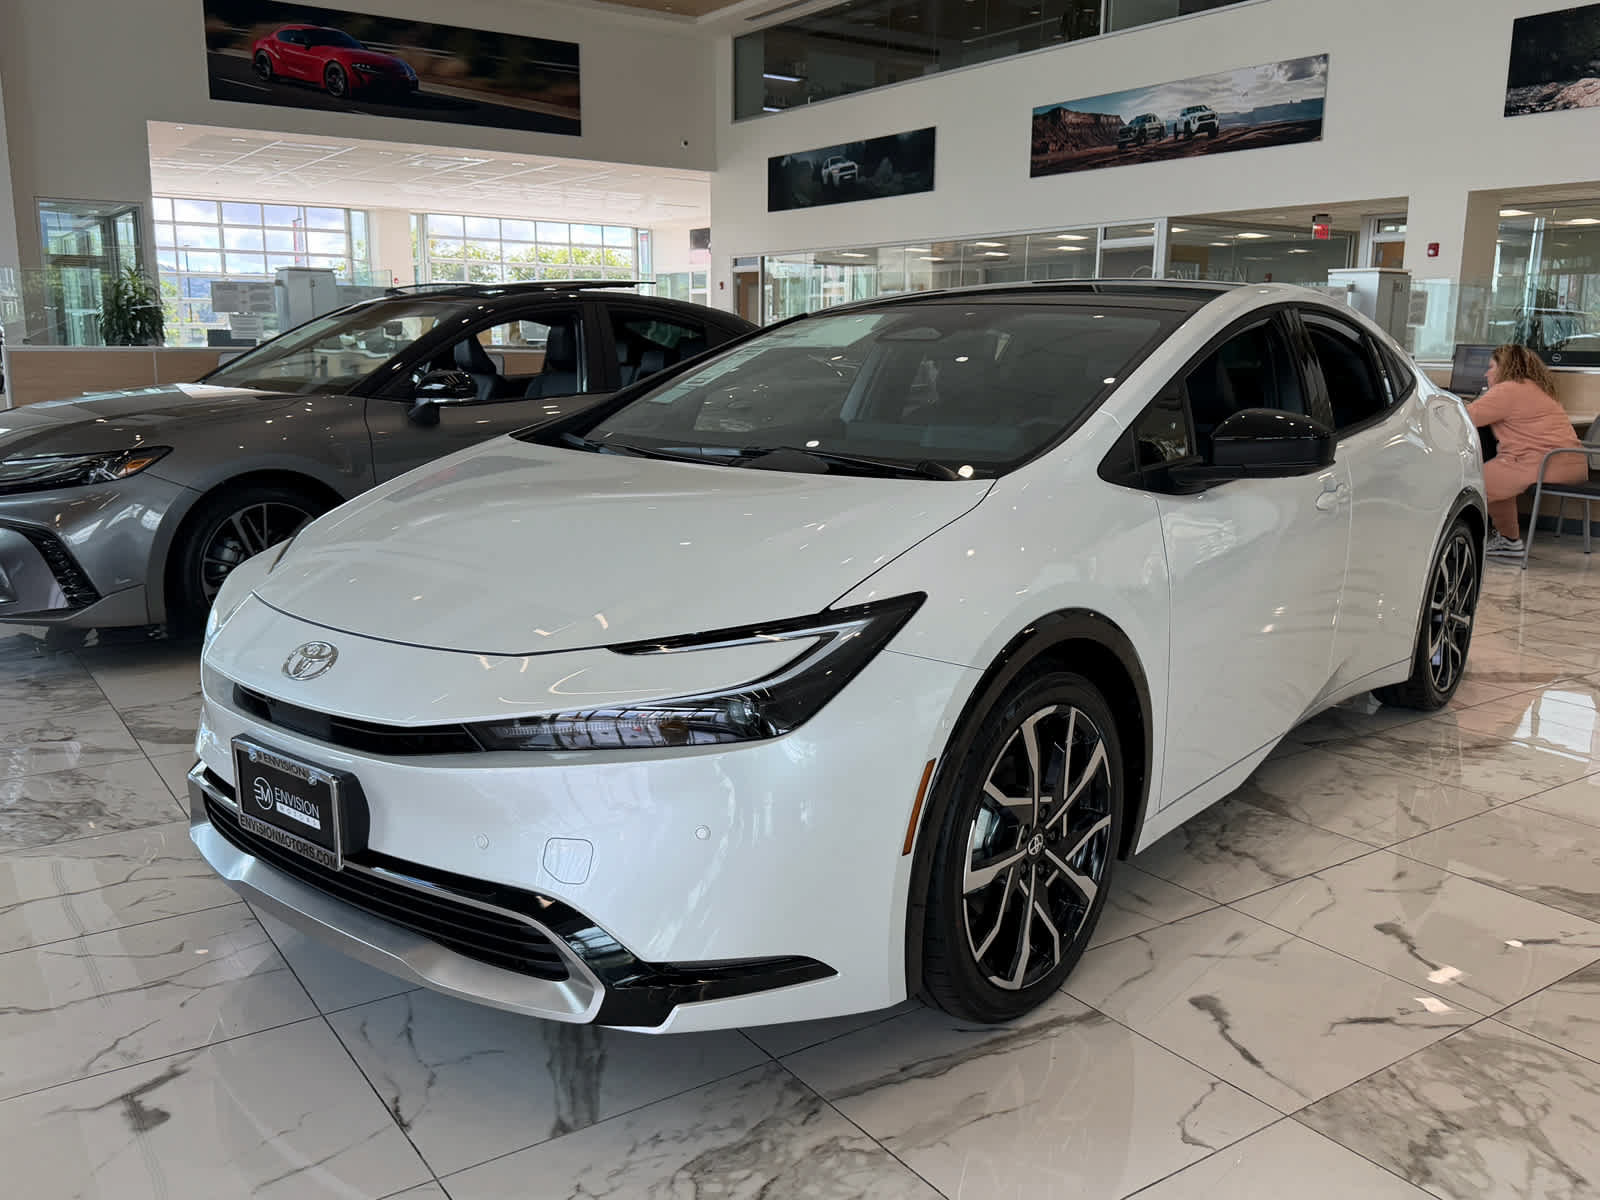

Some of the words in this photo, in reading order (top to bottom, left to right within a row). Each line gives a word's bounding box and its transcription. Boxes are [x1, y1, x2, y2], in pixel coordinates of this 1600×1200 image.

[263, 754, 306, 778] ENVISION
[275, 787, 320, 819] ENVISION
[240, 815, 337, 867] ENVISIONMOTORS.COM
